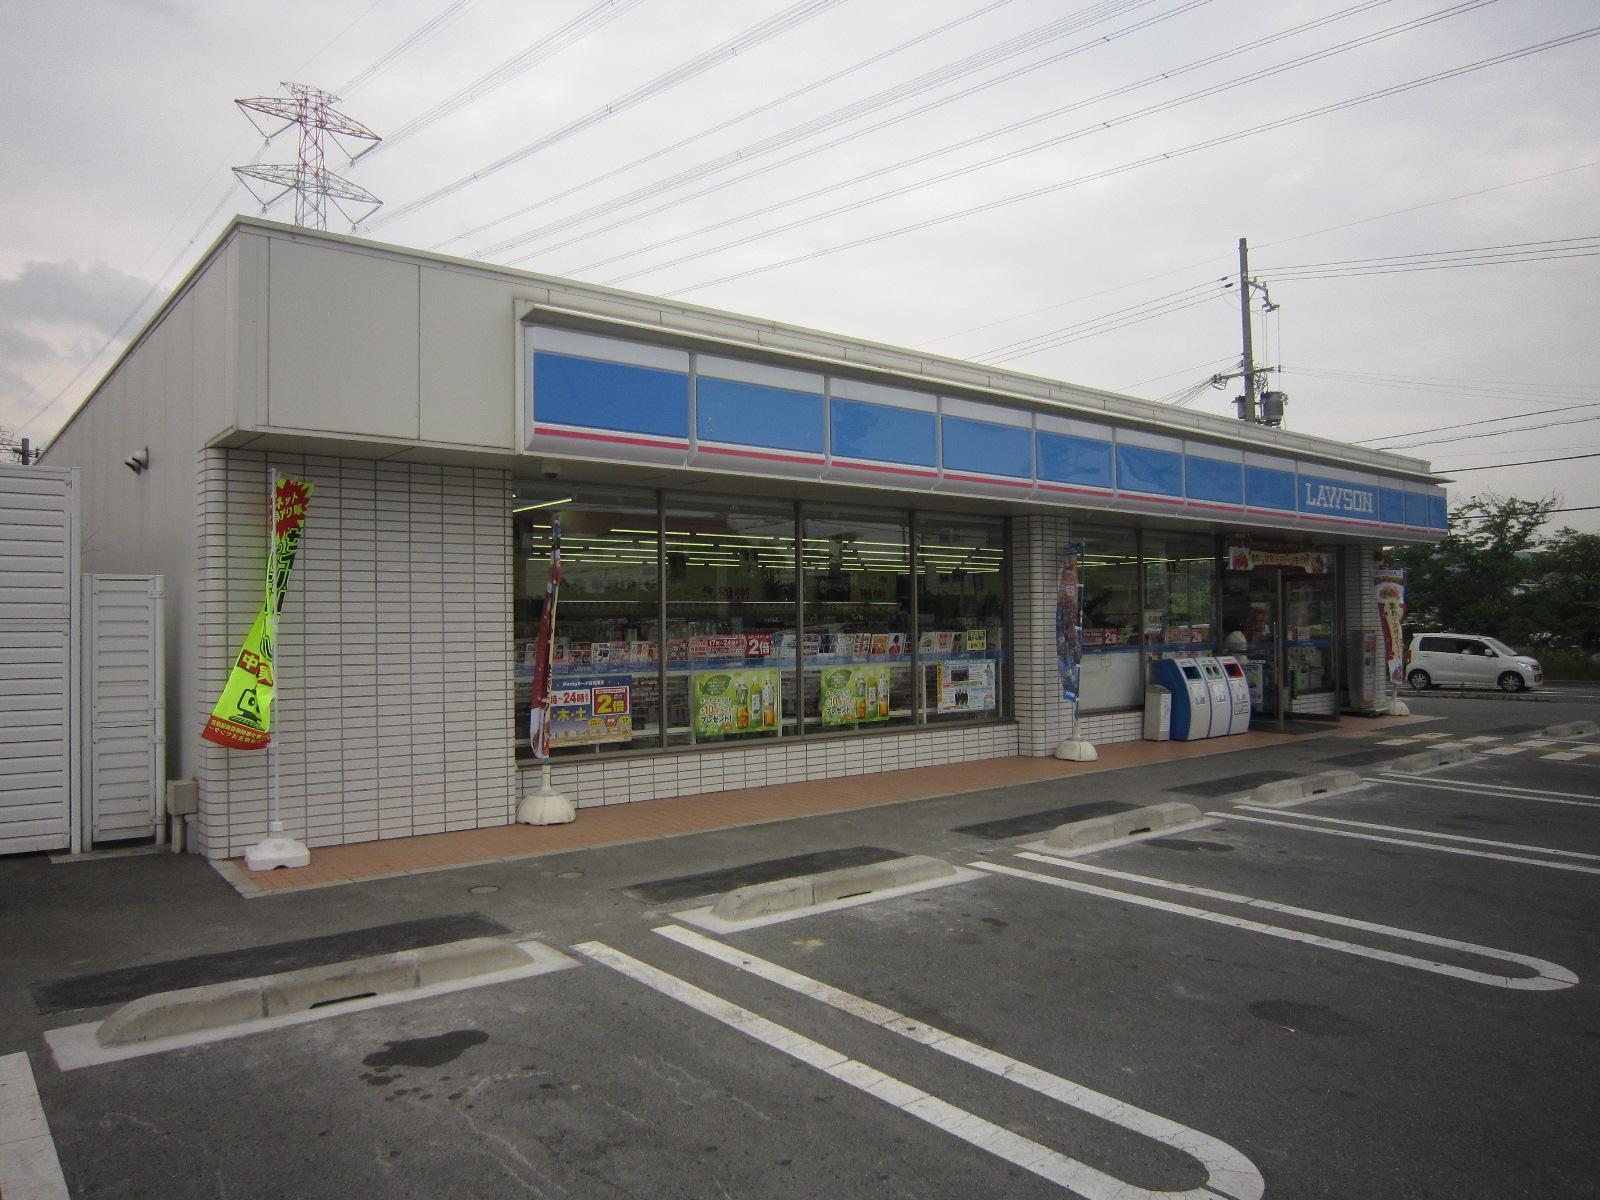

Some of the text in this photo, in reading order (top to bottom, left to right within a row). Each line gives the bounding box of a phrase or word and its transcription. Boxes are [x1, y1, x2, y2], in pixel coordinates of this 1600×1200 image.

[1304, 483, 1374, 514] LAWSON
[748, 639, 770, 655] 2倍
[597, 694, 625, 714] 2倍
